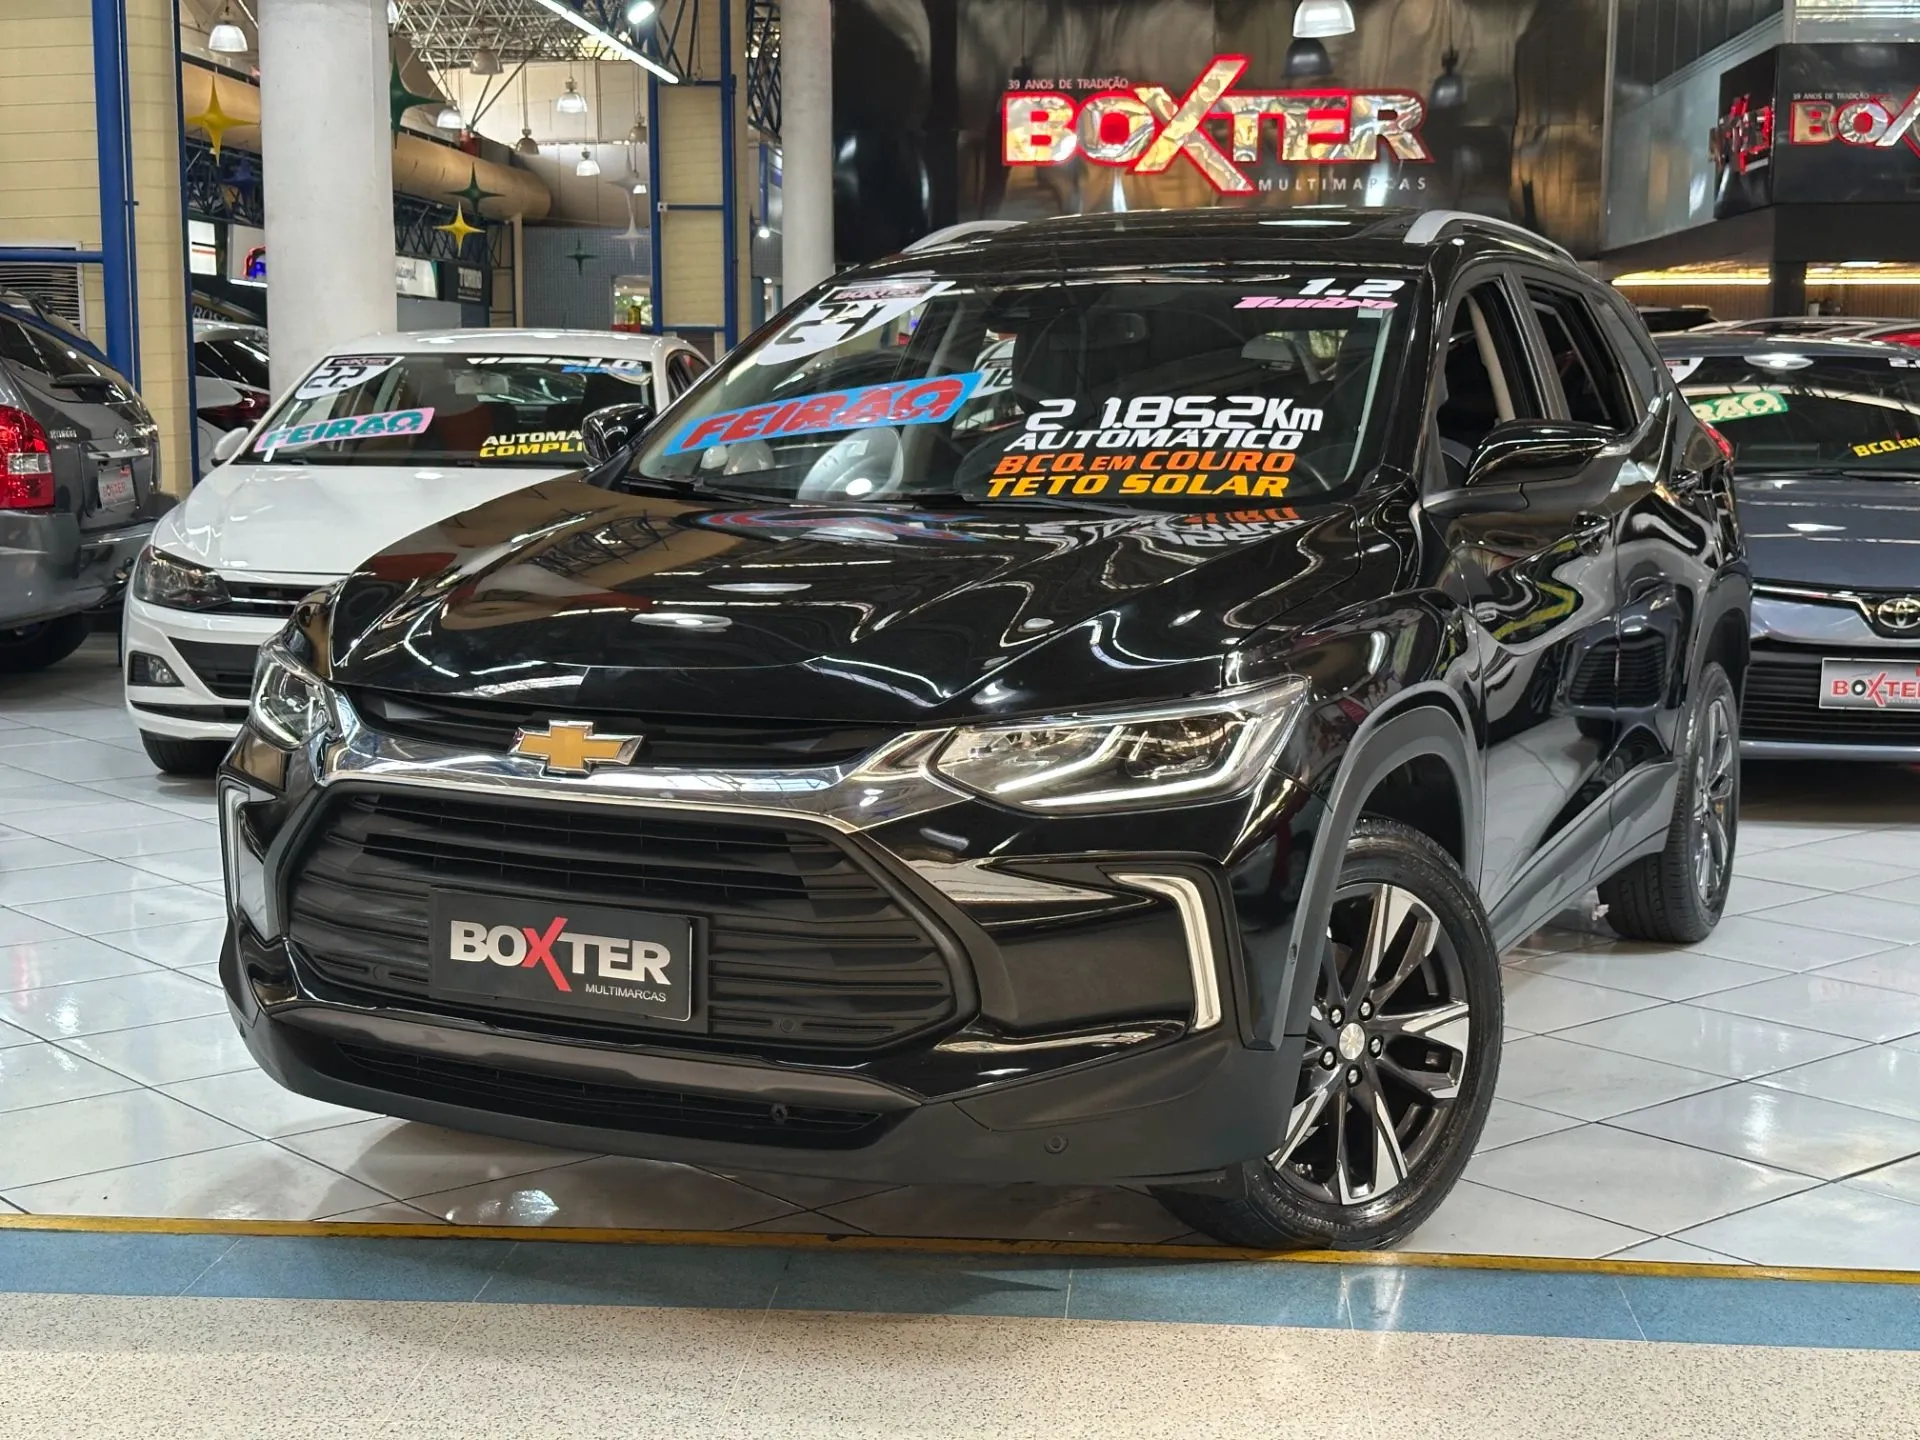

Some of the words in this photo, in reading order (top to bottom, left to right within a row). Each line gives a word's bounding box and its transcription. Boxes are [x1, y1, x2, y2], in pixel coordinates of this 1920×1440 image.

[1008, 79, 1020, 90] 39
[1025, 79, 1054, 90] ANOS
[1059, 79, 1073, 89] DE
[1078, 76, 1129, 92] TRADIÇÃO
[1803, 92, 1822, 100] ANOS
[1825, 92, 1834, 100] DE
[1002, 54, 1434, 196] BOXTER
[1299, 277, 1405, 298] 1.2
[303, 366, 368, 388] 22
[263, 411, 424, 449] FEIRÃO
[1091, 455, 1136, 471] EM
[1139, 451, 1296, 473] COURO
[987, 475, 1109, 498] TETO
[1119, 474, 1289, 497] SOLAR
[1831, 672, 1920, 707] BOXTE
[450, 917, 671, 992] BOXTER
[586, 983, 666, 1002] MULTIMARCAS
